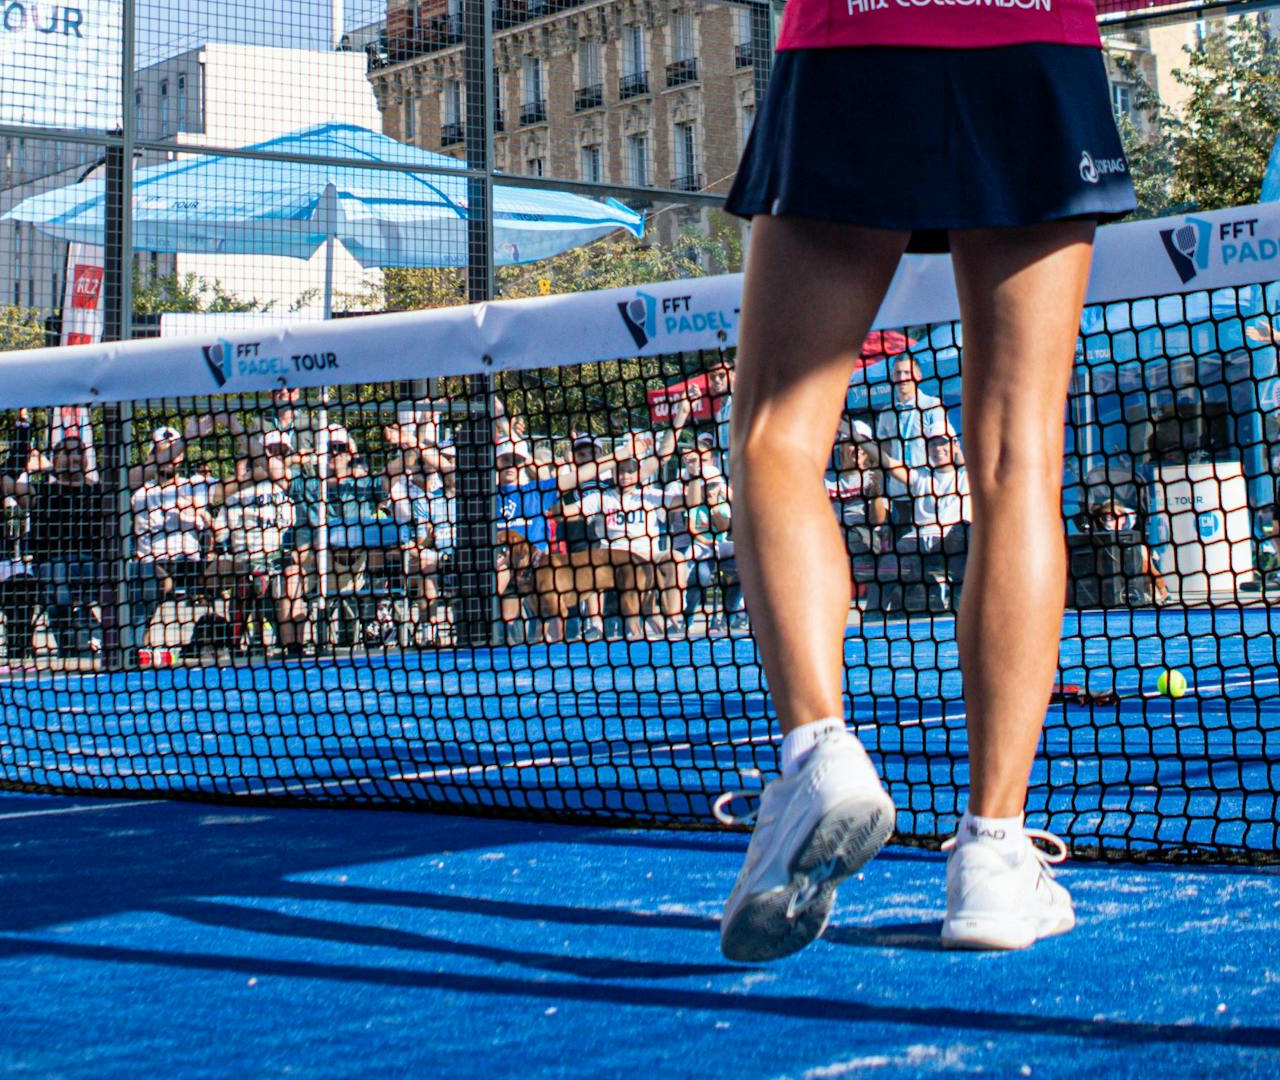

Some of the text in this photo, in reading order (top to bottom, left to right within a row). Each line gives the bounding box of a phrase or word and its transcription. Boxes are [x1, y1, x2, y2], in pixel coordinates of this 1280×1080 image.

[1220, 219, 1258, 240] FFT
[662, 296, 692, 314] FFT
[665, 311, 732, 334] PADEL
[237, 342, 260, 358] FFT
[238, 352, 339, 376] PADEL TOUR
